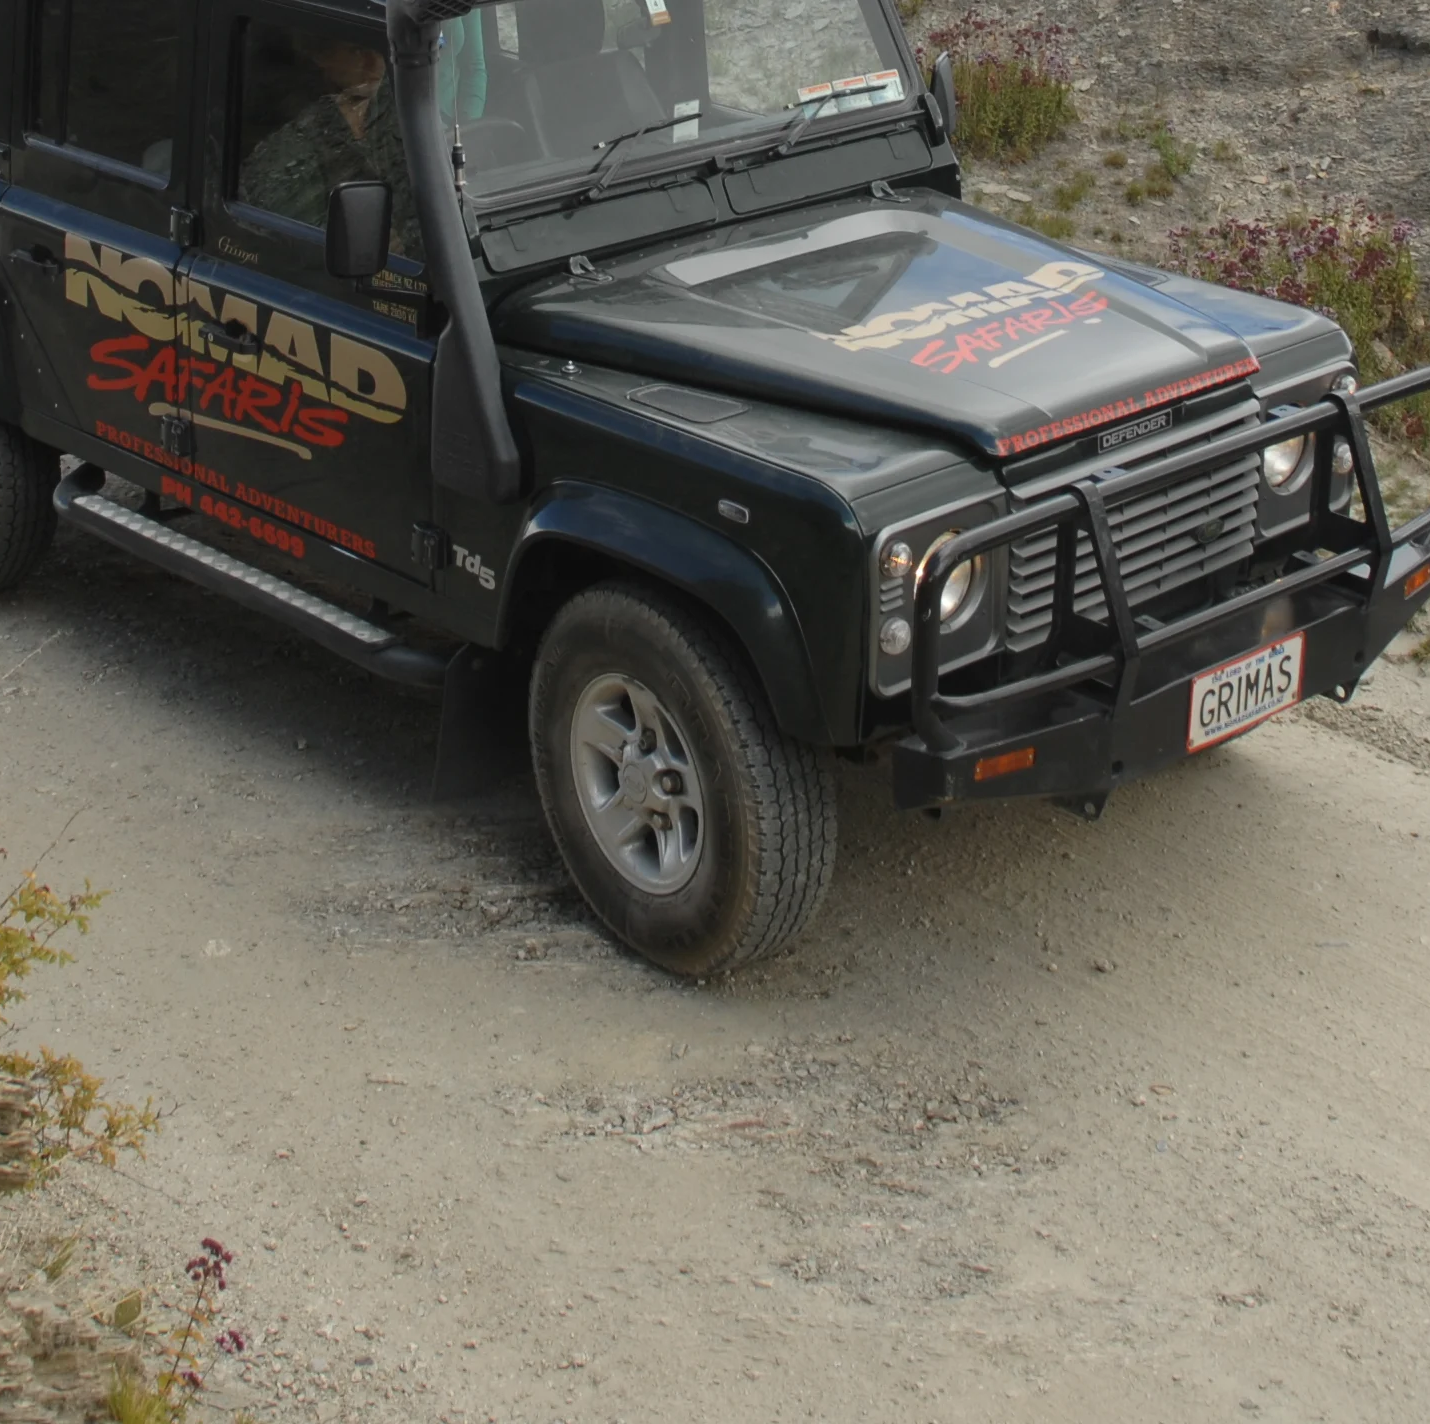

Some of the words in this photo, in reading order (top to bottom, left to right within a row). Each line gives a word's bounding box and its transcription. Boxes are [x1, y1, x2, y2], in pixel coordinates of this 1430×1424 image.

[65, 232, 407, 424] NOMAD
[833, 261, 1105, 351] NOMAD
[911, 290, 1109, 374] SAFARIS
[87, 335, 349, 448] SAFARIS
[996, 397, 1143, 457] PROFESSIONAL
[1103, 414, 1167, 448] DEFENDER
[95, 420, 231, 494] PROFESSIONAL
[235, 481, 376, 559] ADVENTURERS
[161, 475, 192, 507] PH
[199, 494, 305, 559] 442-6699
[453, 544, 496, 590] Td5
[1199, 654, 1292, 727] GRIMAS
